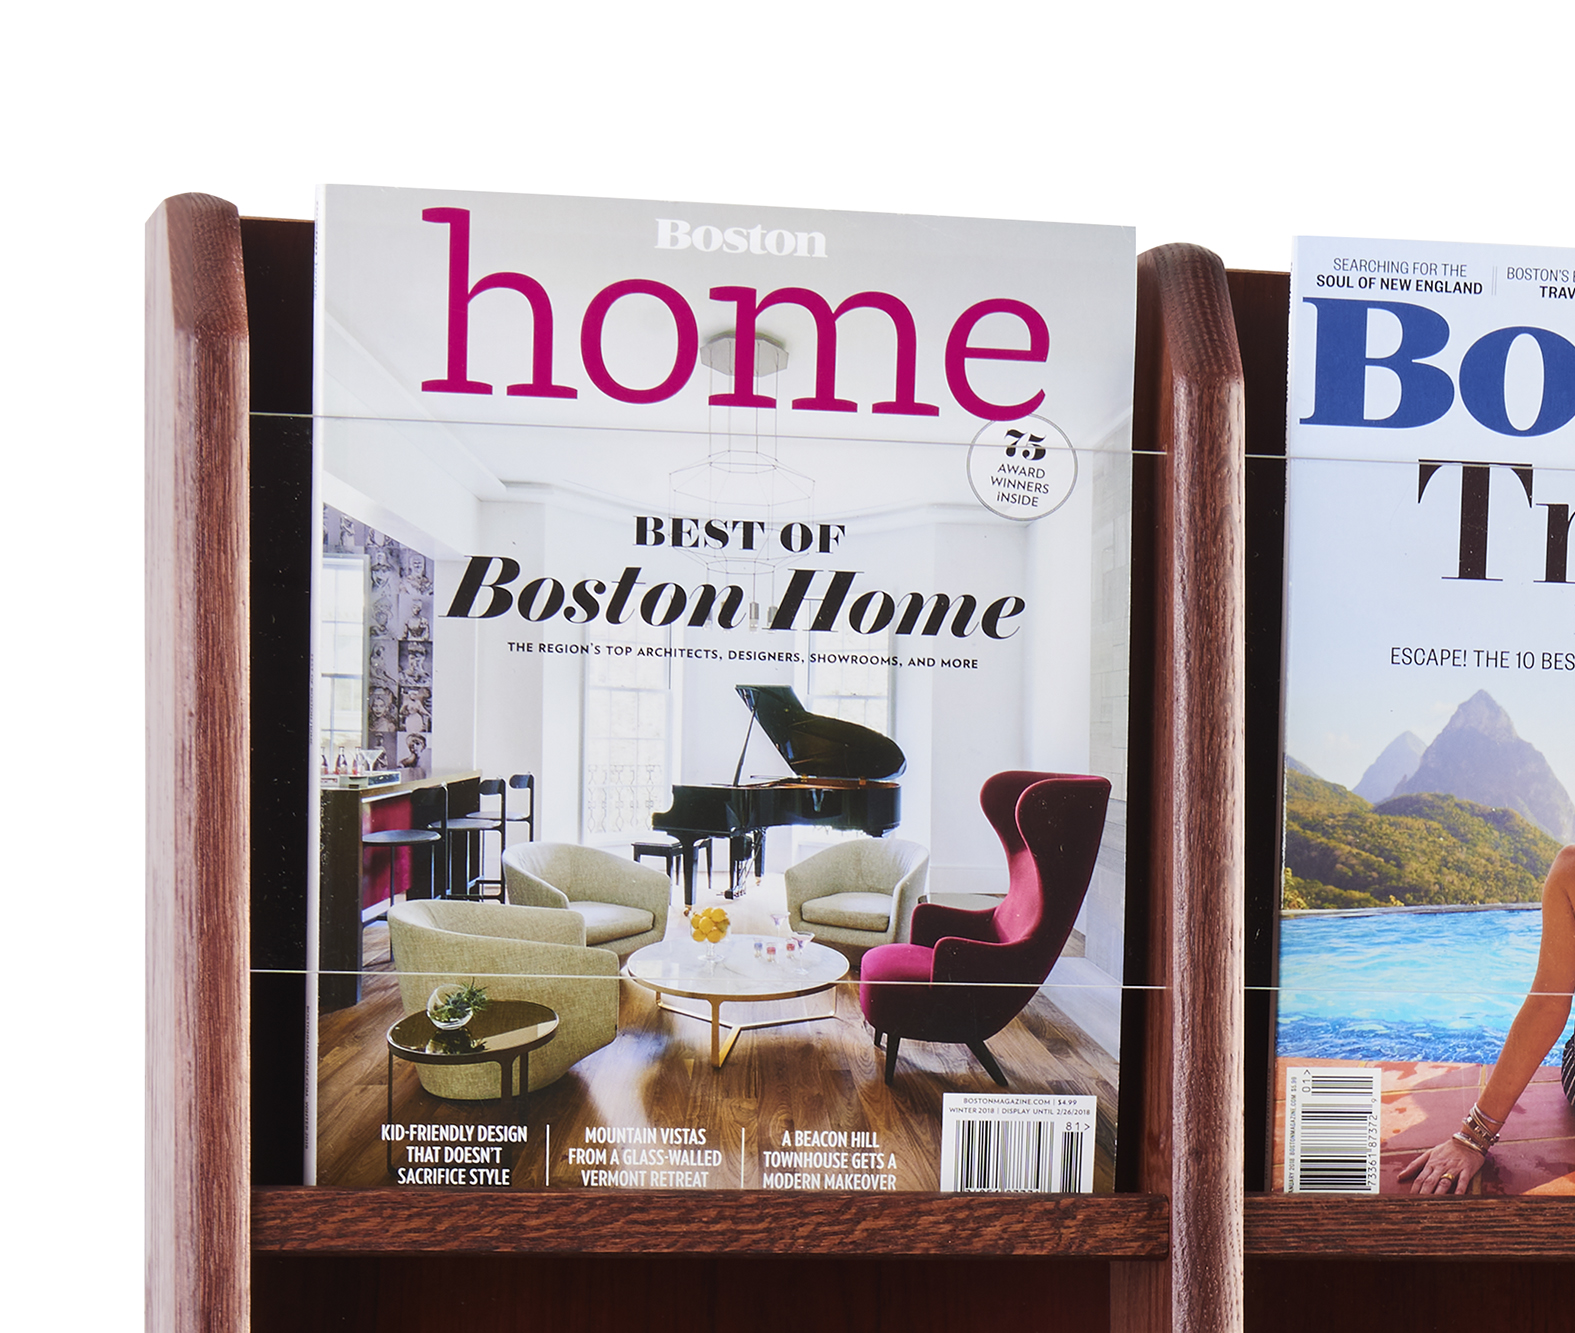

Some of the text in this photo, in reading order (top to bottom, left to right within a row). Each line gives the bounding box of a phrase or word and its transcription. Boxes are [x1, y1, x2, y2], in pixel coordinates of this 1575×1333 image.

[655, 218, 829, 258] Boston
[1333, 258, 1467, 277] SEARCHING FOR THE
[1316, 274, 1482, 295] SOUL OF NEW ENGLAND
[422, 207, 1050, 420] home
[1004, 429, 1046, 460] 75
[998, 464, 1045, 478] AWARD
[991, 476, 1049, 494] WINNERS
[633, 515, 845, 553] BEST OF
[438, 554, 1026, 639] Boston Home
[508, 642, 978, 669] THE REGION'S TOP ARCHITECTS, DESIGNERS, SHOWROOMS, AND MORE
[1391, 648, 1468, 667] ESCAPE!
[1474, 649, 1509, 668] THE
[1516, 651, 1534, 669] 10
[382, 1124, 528, 1143] KID-FRIENDLY DESIGN
[585, 1126, 706, 1145] MOUNTAIN VISTAS
[398, 1166, 510, 1185] SACRIFICE STYLE
